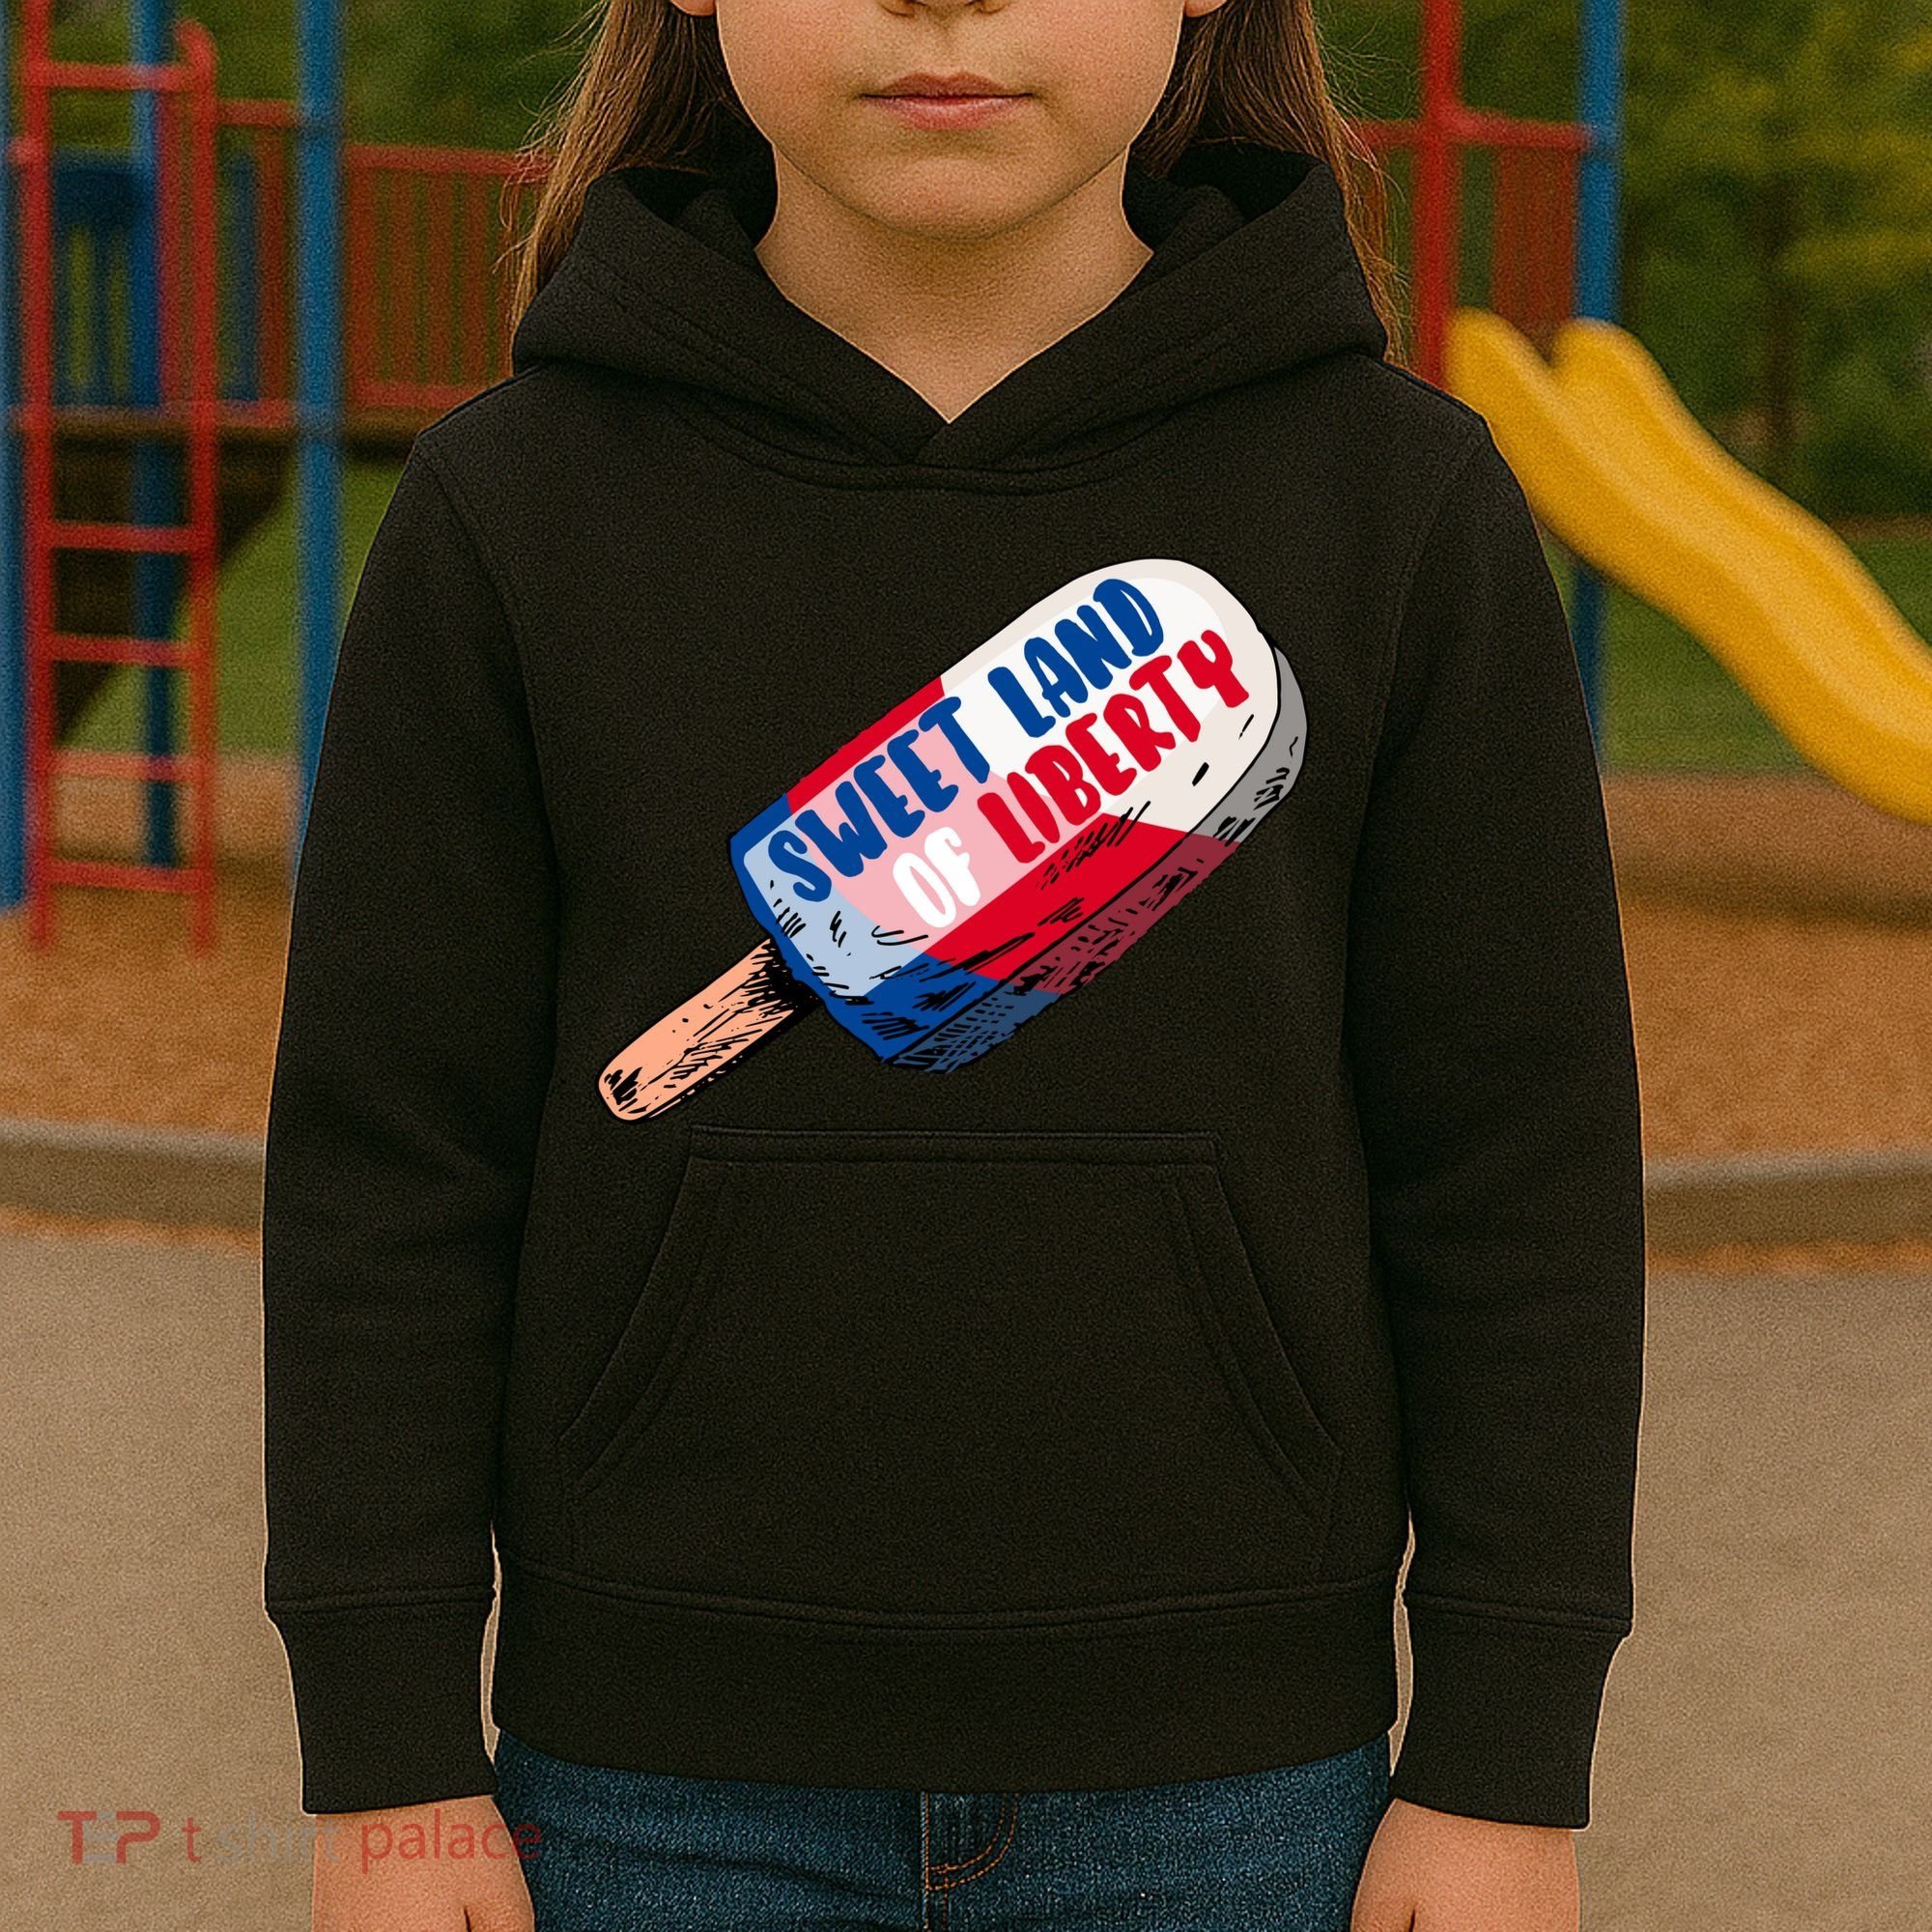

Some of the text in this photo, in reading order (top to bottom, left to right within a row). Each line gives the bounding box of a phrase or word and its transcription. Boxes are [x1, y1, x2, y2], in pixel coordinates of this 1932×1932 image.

[767, 578, 1164, 902] SWEET LAND
[893, 629, 1250, 928] OF LIBERTY
